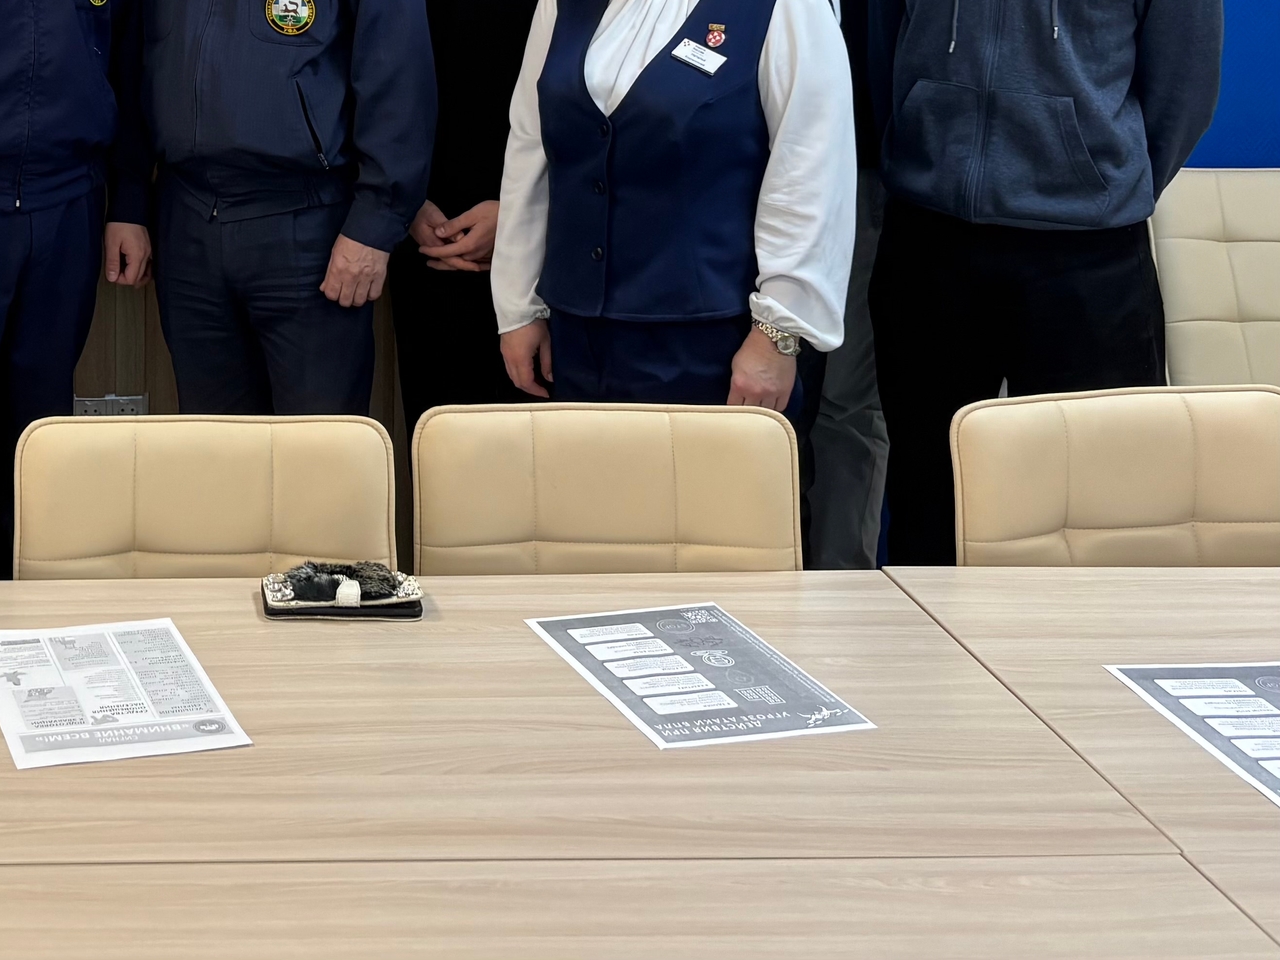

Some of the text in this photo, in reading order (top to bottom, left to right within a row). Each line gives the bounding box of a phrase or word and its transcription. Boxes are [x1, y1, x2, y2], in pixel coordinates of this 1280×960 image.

[693, 717, 737, 726] АТАКИ
[739, 711, 791, 722] УГРОЗЕ
[35, 723, 190, 743] «ВНИМАНИЕ ВСЕМ!»
[661, 720, 763, 737] ДЕЙСТВИЯ ПРИ
[98, 734, 139, 743] СИГНАЛ
